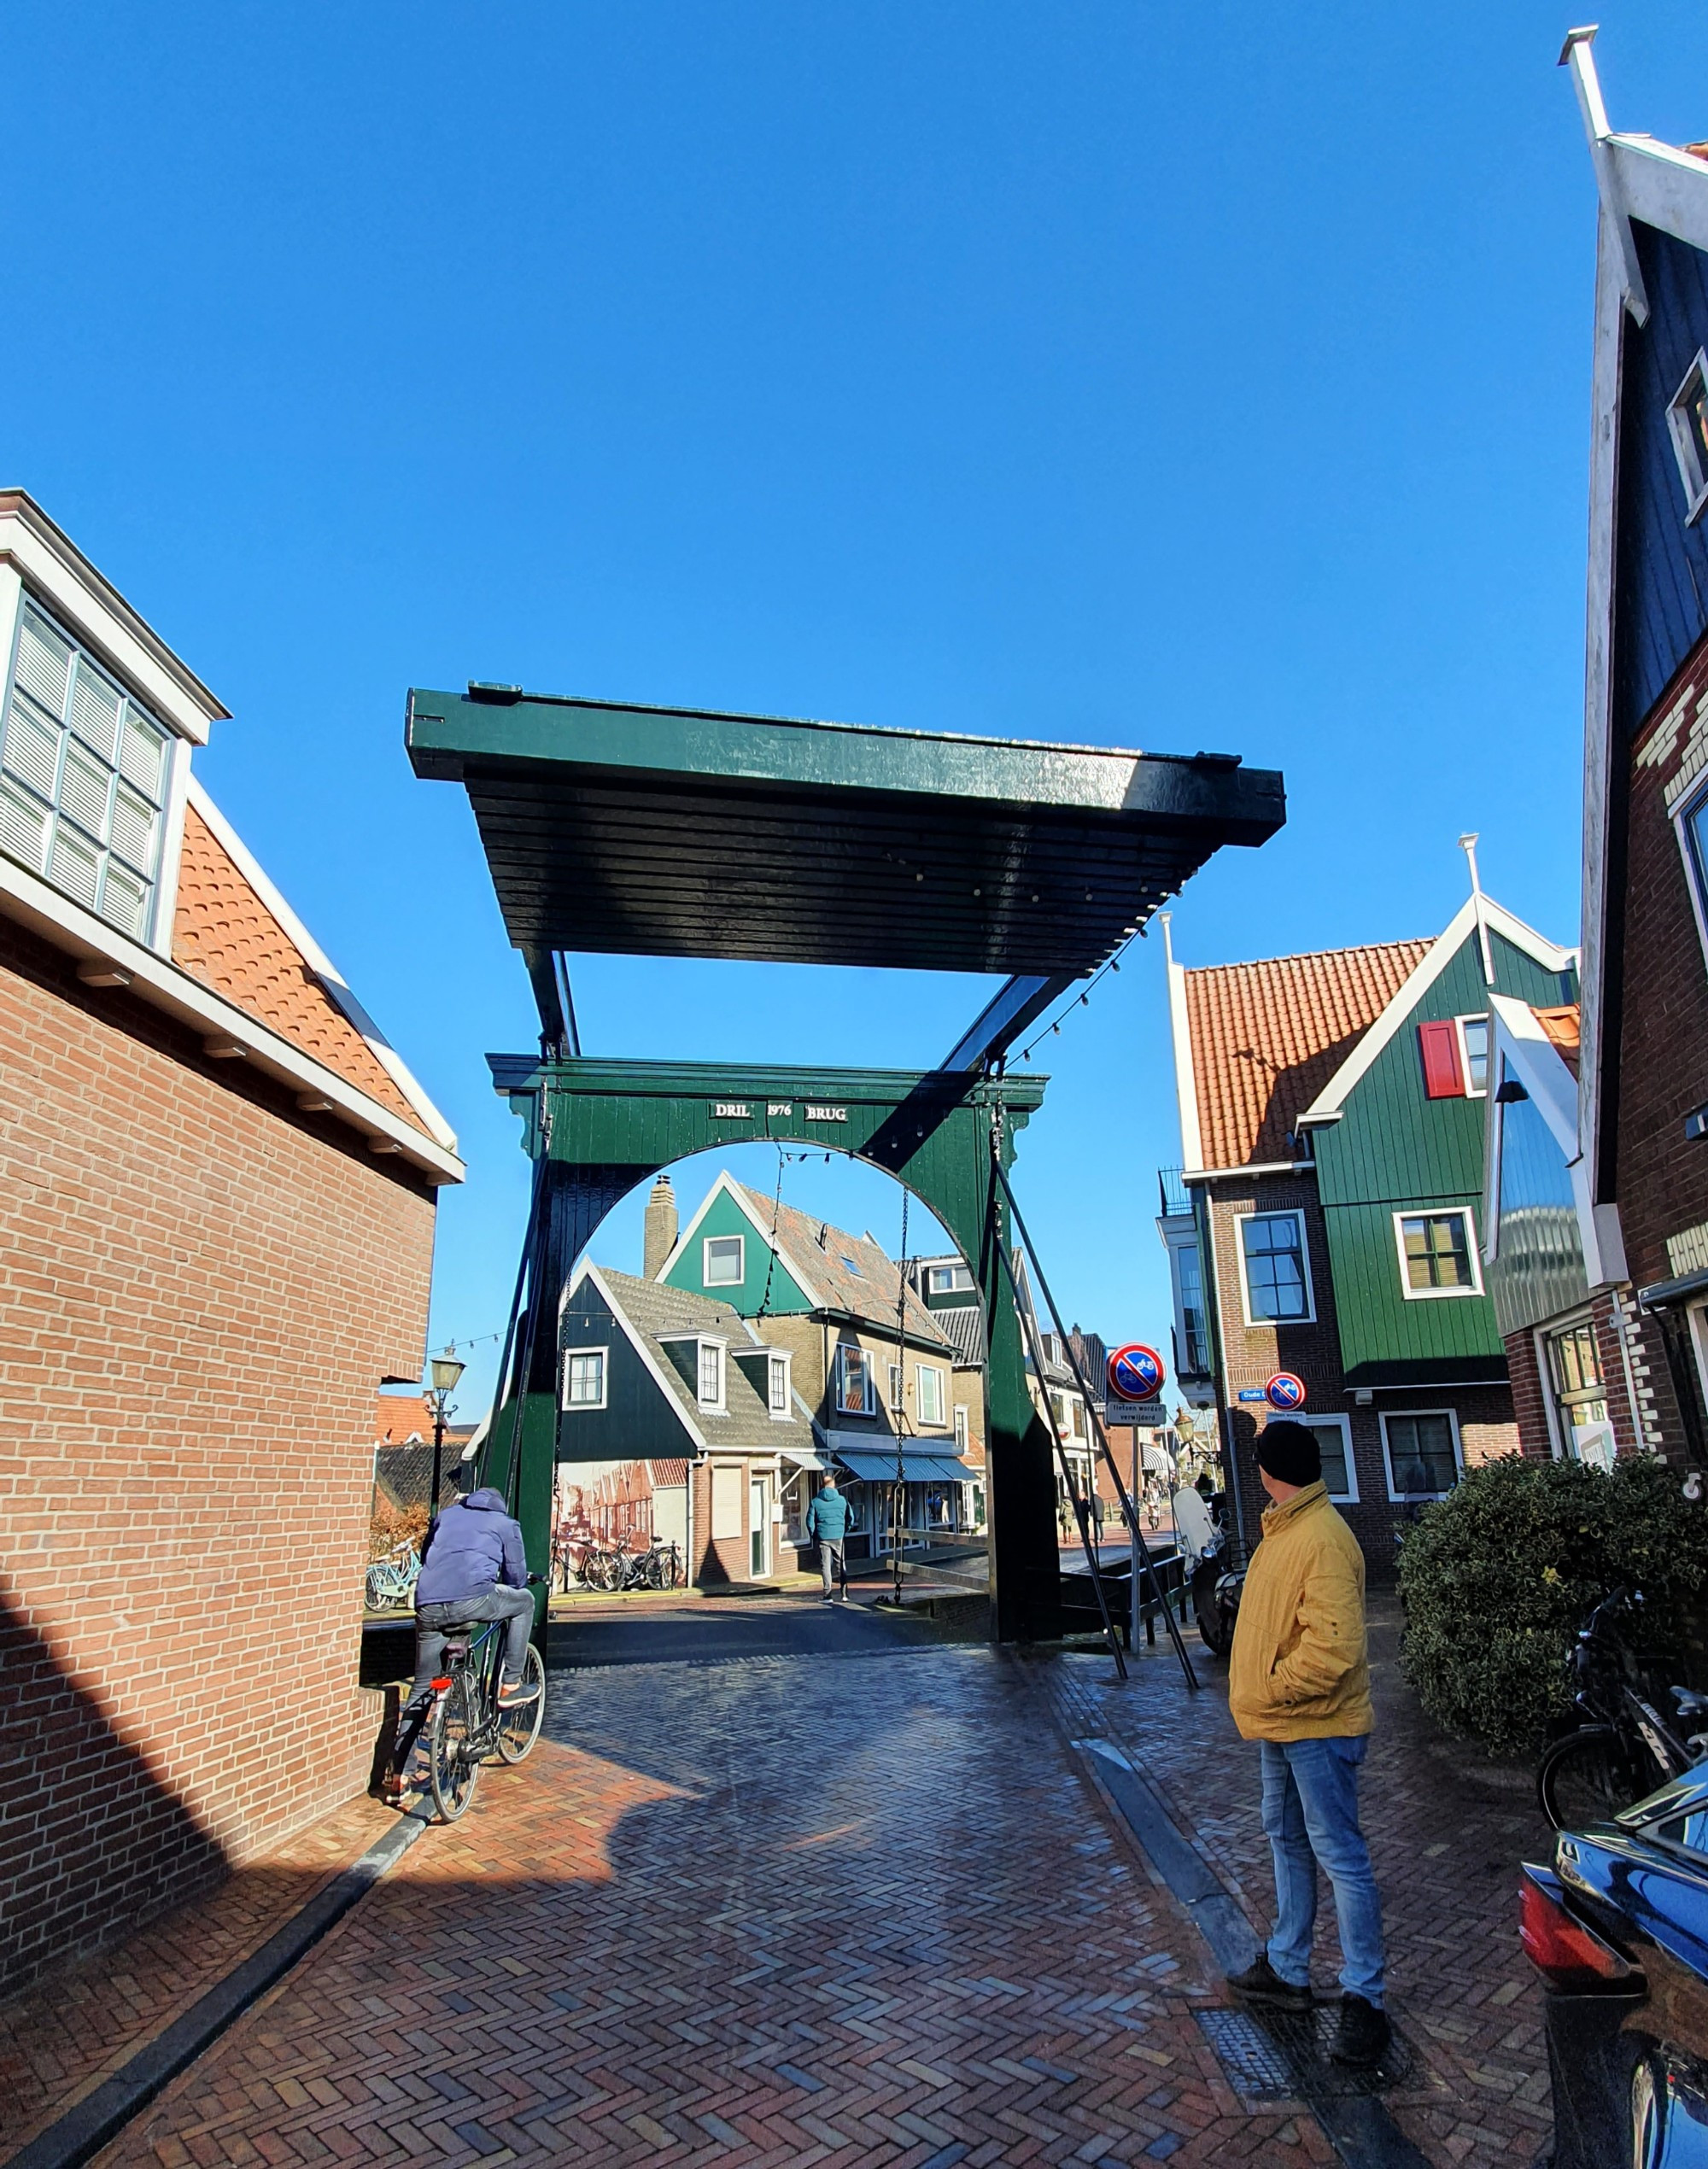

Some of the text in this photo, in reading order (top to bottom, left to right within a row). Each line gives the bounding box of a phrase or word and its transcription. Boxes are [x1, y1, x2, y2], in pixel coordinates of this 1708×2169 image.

[716, 1104, 846, 1120] DRIL 1976 BRUG
